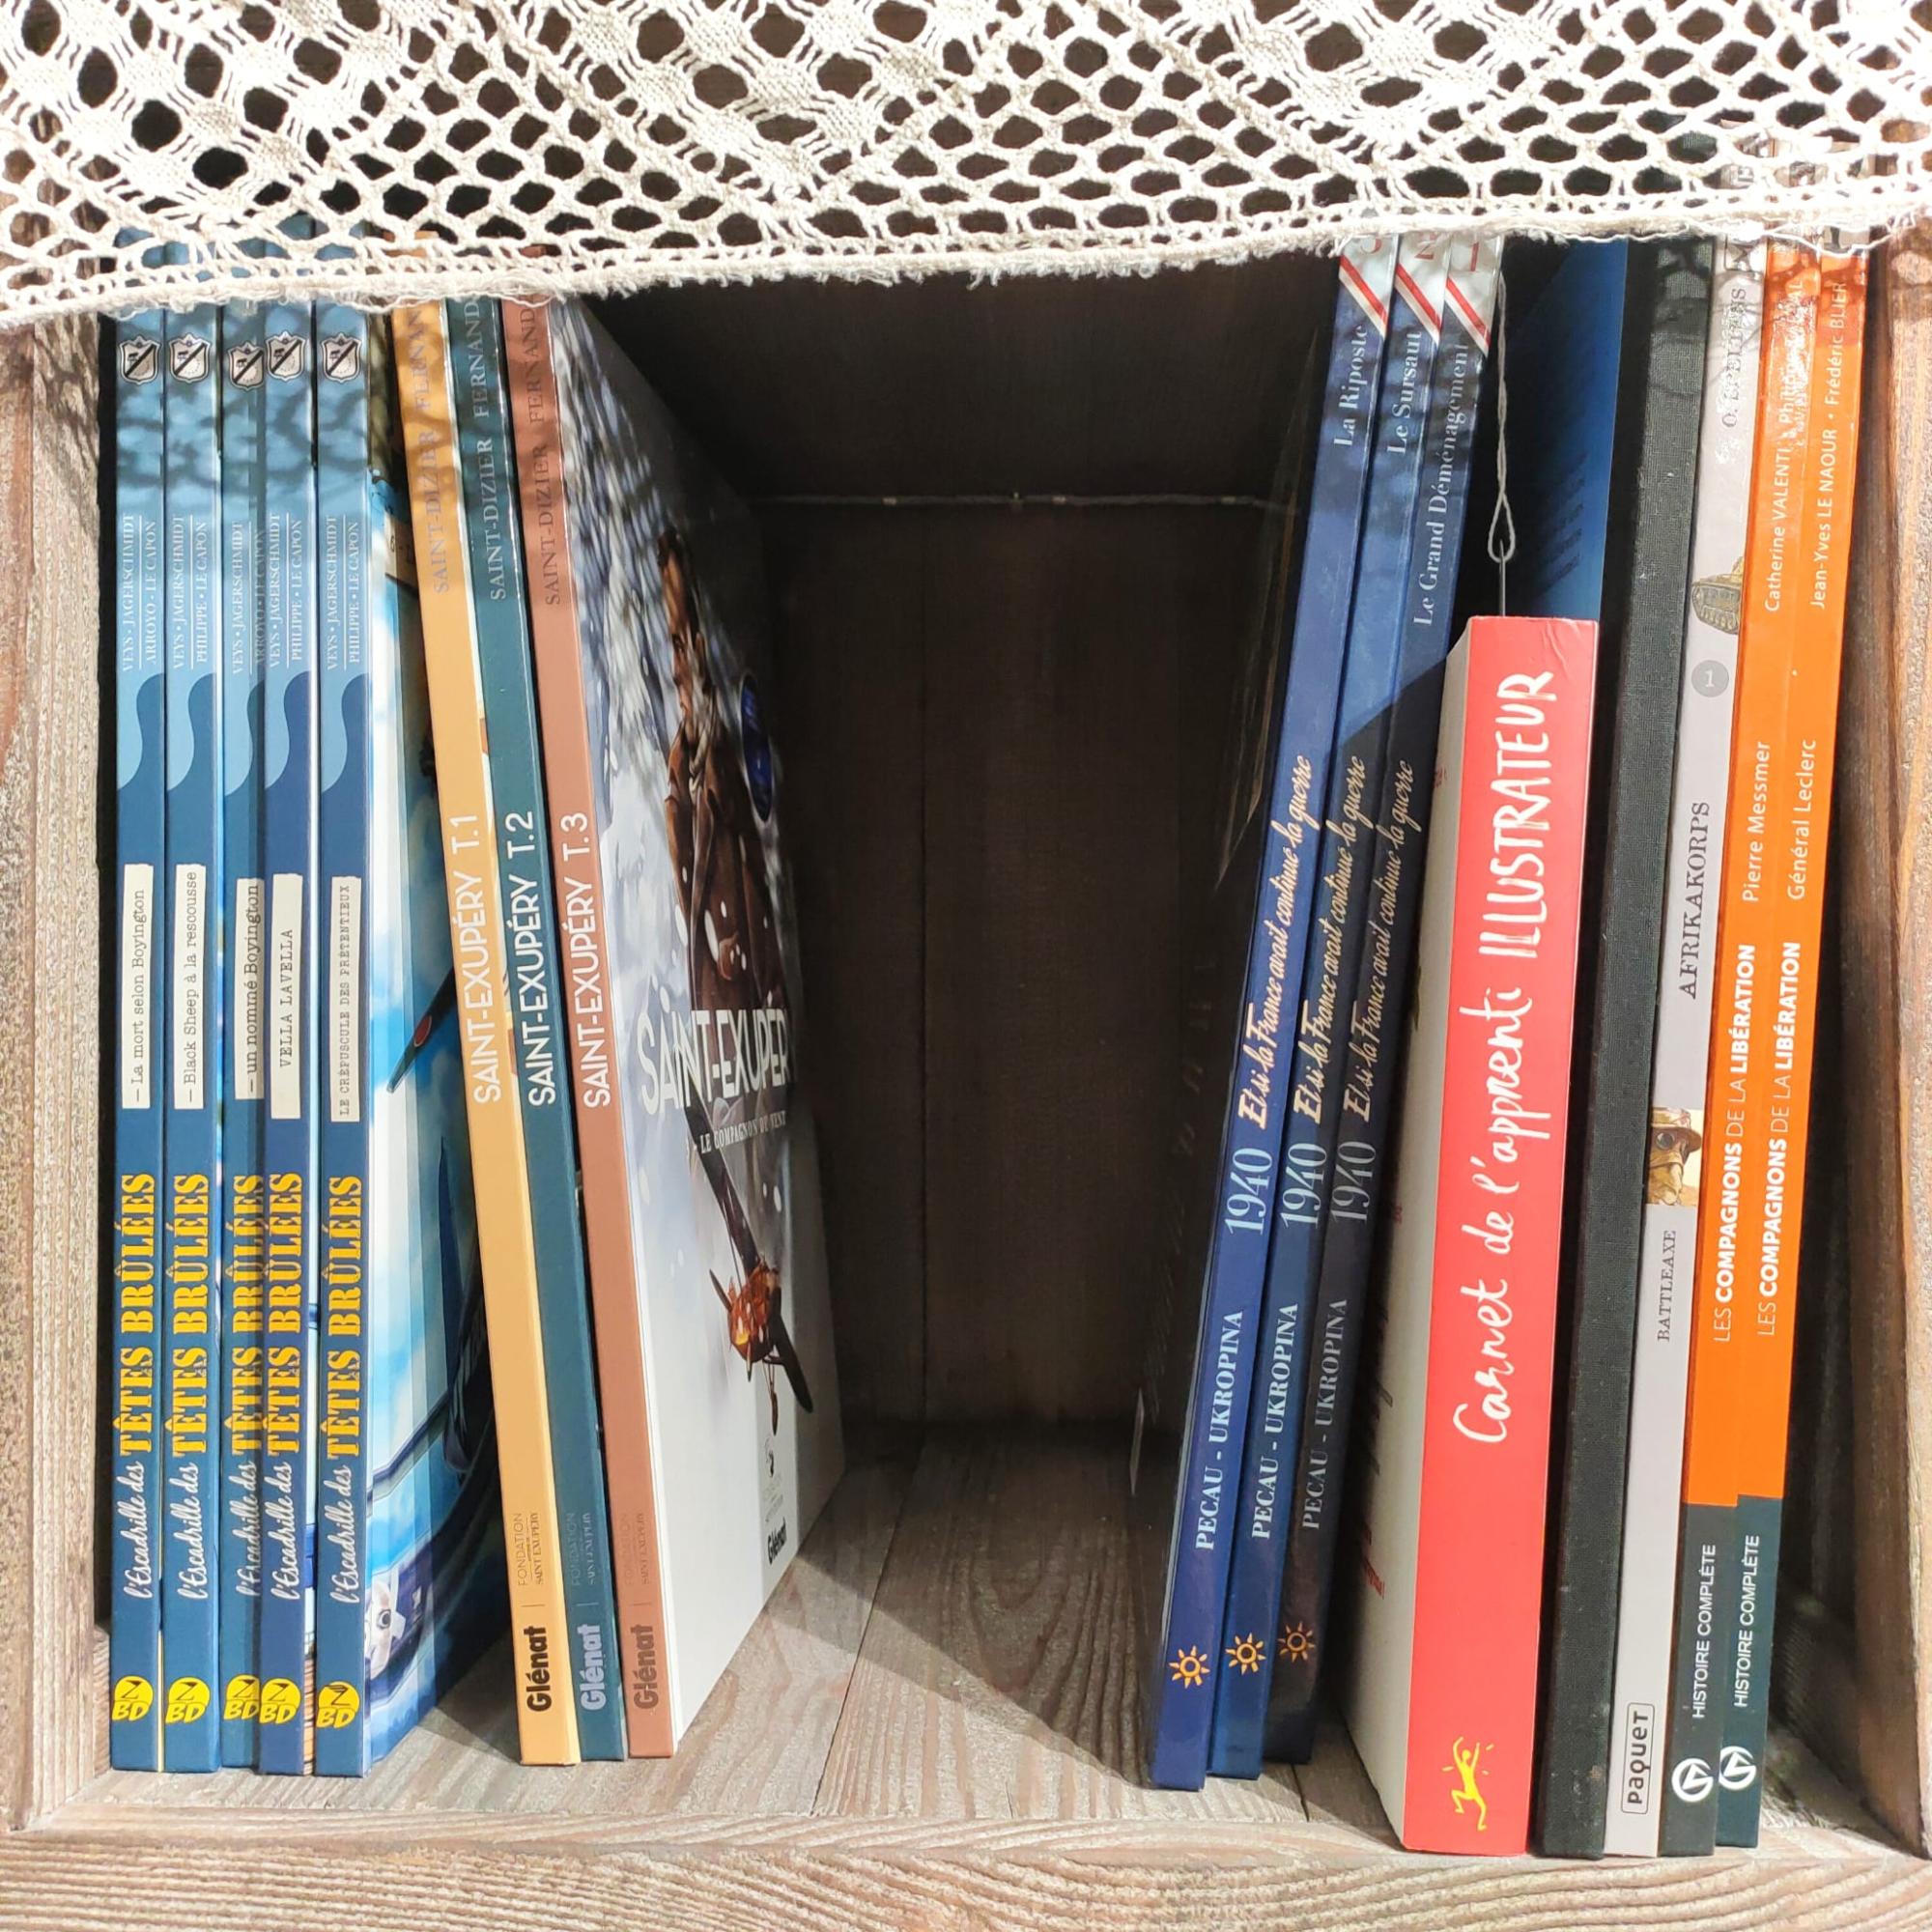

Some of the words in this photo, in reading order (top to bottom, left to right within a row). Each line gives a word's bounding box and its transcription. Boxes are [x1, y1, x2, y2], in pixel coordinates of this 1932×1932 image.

[1830, 282, 1845, 327] BLIER
[464, 300, 490, 418] FERNAND
[520, 307, 545, 423] FERNAND
[1338, 326, 1368, 410] Riposte
[1392, 331, 1421, 418] Sursaut
[1825, 336, 1844, 405] Frédéric
[1334, 419, 1355, 446] La
[1387, 425, 1408, 454] Le
[1428, 344, 1468, 513] Déménagement
[1772, 448, 1791, 521] VALENTI
[1819, 429, 1835, 493] NAOUR
[417, 432, 449, 595] SAINT-DIZIER
[476, 439, 506, 600] SAINT-DIZIER
[532, 443, 561, 605] SAINT-DIZIER
[1816, 499, 1833, 517] LE
[123, 514, 135, 625] JAGERSCHMIDT
[146, 521, 156, 570] CAPON
[173, 514, 186, 623] JAGERSCHMIDT
[196, 522, 207, 570] CAPON
[232, 521, 245, 628] JAGERSCHMIDT
[269, 513, 283, 620] JAGERSCHMIDT
[292, 520, 301, 568] CAPON
[327, 516, 340, 624] JAGERSCHMIDT
[349, 523, 358, 570] CAPON
[1418, 522, 1446, 590] Grand
[1764, 526, 1785, 611] Catherine
[1810, 524, 1831, 609] Jean-Yves
[146, 575, 156, 591] LE
[196, 574, 207, 589] LE
[292, 572, 301, 587] LE
[349, 574, 359, 589] LE
[1413, 597, 1434, 626] Le
[123, 637, 133, 671] VEYS
[146, 603, 156, 665] ARROYO
[174, 635, 185, 669] VEYS
[196, 602, 207, 663] PHILIPPE
[232, 640, 243, 674] VEYS
[270, 633, 280, 668] VEYS
[292, 601, 302, 660] PHILIPPE
[327, 635, 338, 670] VEYS
[349, 602, 359, 663] PHILIPPE
[1704, 668, 1715, 688] 1
[1289, 755, 1320, 830] guerre
[1343, 755, 1374, 829] guerre
[1391, 760, 1422, 832] guerre
[1747, 742, 1770, 835] Messmer
[1793, 740, 1816, 812] Leclerc
[450, 814, 480, 855] T.1
[505, 810, 535, 859] T.2
[560, 812, 590, 862] T.3
[1270, 820, 1302, 848] la
[1325, 819, 1356, 846] la
[1376, 825, 1405, 849] la
[1478, 671, 1556, 958] ILLUSTRATEUR
[1268, 846, 1299, 926] continué
[1743, 841, 1763, 901] Pierre
[1787, 821, 1809, 900] Général
[131, 890, 147, 968] Boyington
[186, 872, 196, 948] rescousse
[244, 885, 260, 974] Boyington
[1678, 802, 1709, 1000] AFRIKAKORPS
[183, 973, 197, 982] à
[185, 953, 197, 968] la
[280, 929, 293, 1006] LAVELLA
[1263, 920, 1288, 979] avait
[1318, 918, 1343, 976] avait
[1368, 921, 1391, 977] avait
[132, 975, 145, 1014] selon
[185, 989, 199, 1035] Sheep
[243, 980, 257, 1044] nommé
[339, 981, 350, 1006] DES
[452, 871, 501, 1103] SAINT-EXUPÉRY
[507, 874, 556, 1106] SAINT-EXUPÉRY
[562, 876, 611, 1108] SAINT-EXUPÉRY
[1245, 978, 1283, 1048] France
[1301, 975, 1337, 1043] France
[1350, 977, 1385, 1042] France
[1729, 945, 1755, 1073] LIBÉRATION
[1773, 942, 1801, 1069] LIBÉRATION
[133, 1020, 144, 1058] mort
[184, 1041, 197, 1085] Black
[247, 1051, 257, 1073] un
[280, 1013, 293, 1067] VELLA
[1243, 1047, 1273, 1072] la
[1298, 1041, 1329, 1067] la
[1349, 1041, 1377, 1067] la
[131, 1065, 144, 1084] La
[1248, 1069, 1269, 1096] si
[1293, 1083, 1321, 1124] Et
[1304, 1065, 1325, 1091] si
[1344, 1083, 1371, 1122] Et
[1354, 1065, 1378, 1090] si
[1459, 987, 1551, 1194] l'apprenti
[1727, 1078, 1747, 1103] LA
[1772, 1075, 1792, 1099] LA
[339, 1099, 350, 1116] LE
[1237, 1088, 1266, 1129] Et
[1726, 1110, 1745, 1137] DE
[1771, 1105, 1789, 1133] DE
[700, 1133, 711, 1153] LE
[1224, 1148, 1272, 1236] 1940
[1280, 1143, 1327, 1229] 1940
[1330, 1141, 1376, 1222] 1940
[1462, 1211, 1514, 1255] de
[1716, 1143, 1743, 1303] COMPAGNONS
[1759, 1139, 1786, 1297] COMPAGNONS
[114, 1174, 155, 1334] BRÛLÉES
[165, 1174, 209, 1334] BRÛLÉES
[225, 1175, 264, 1334] BRÛLÉES
[263, 1173, 301, 1334] BRÛLÉES
[321, 1176, 361, 1337] BRÛLÉES
[1657, 1230, 1676, 1342] BATTLEAXE
[1714, 1307, 1731, 1342] LES
[1757, 1301, 1776, 1336] LES
[1208, 1311, 1242, 1443] UKROPINA
[1264, 1303, 1297, 1434] UKROPINA
[1452, 1279, 1514, 1443] Carnet
[112, 1347, 153, 1457] TÊTES
[165, 1347, 207, 1458] TÊTES
[224, 1347, 263, 1456] TÊTES
[263, 1346, 300, 1457] TÊTES
[320, 1350, 359, 1460] TÊTES
[1302, 1449, 1328, 1529] PECAU
[1315, 1299, 1347, 1426] UKROPINA
[117, 1461, 144, 1496] des
[169, 1462, 198, 1493] des
[229, 1461, 257, 1491] des
[264, 1462, 292, 1493] des
[324, 1465, 352, 1495] des
[1195, 1466, 1223, 1550] PECAU
[1251, 1456, 1278, 1539] PECAU
[117, 1496, 152, 1598] l'Escadrille
[170, 1497, 209, 1599] l'Escadrille
[265, 1497, 299, 1600] l'Escadrille
[325, 1500, 360, 1604] l'Escadrille
[1697, 1545, 1716, 1635] COMPLÈTE
[1740, 1535, 1760, 1626] COMPLÈTE
[524, 1626, 552, 1712] Glénat
[577, 1624, 607, 1710] Glénat
[631, 1625, 659, 1710] Glénat
[1692, 1641, 1710, 1719] HISTOIRE
[1734, 1631, 1753, 1708] HISTOIRE
[112, 1703, 149, 1720] BD
[166, 1703, 206, 1723] BD
[224, 1701, 259, 1719] BD
[260, 1705, 298, 1724] BD
[316, 1707, 355, 1727] BD
